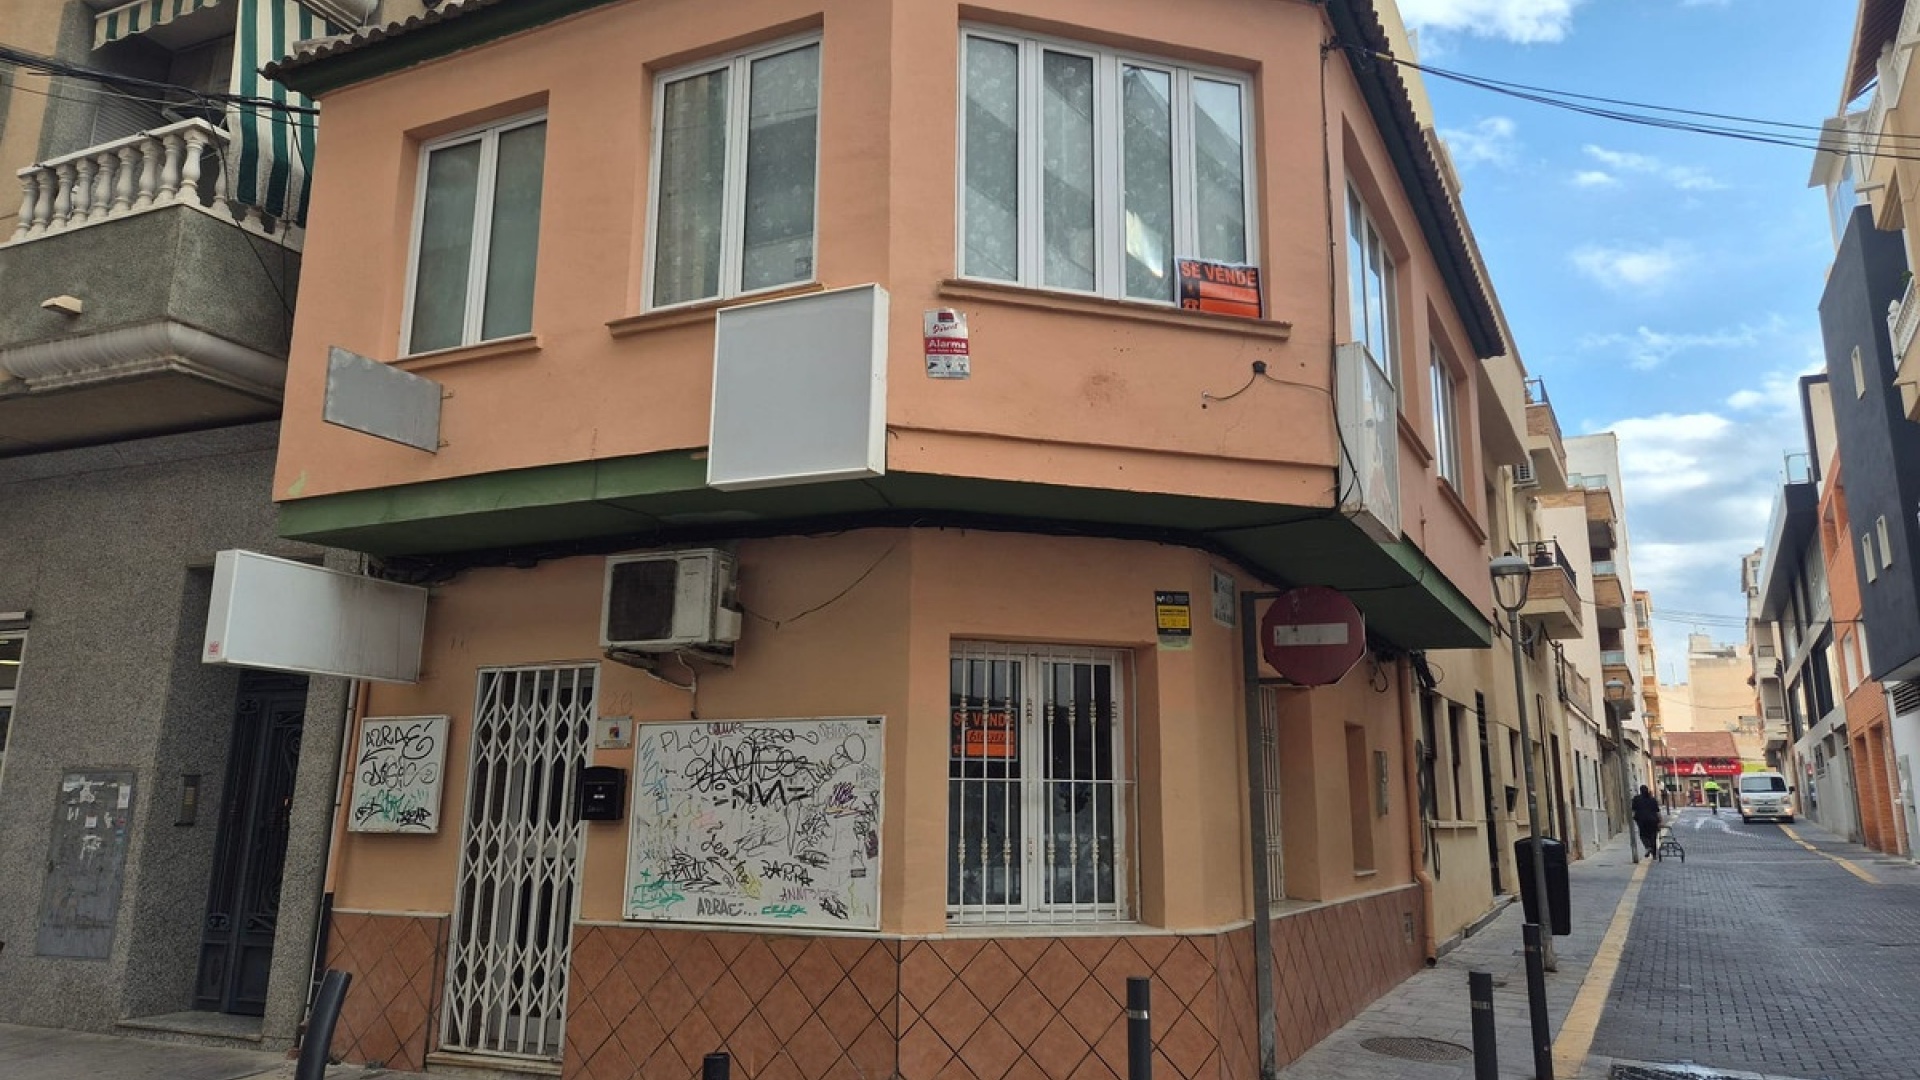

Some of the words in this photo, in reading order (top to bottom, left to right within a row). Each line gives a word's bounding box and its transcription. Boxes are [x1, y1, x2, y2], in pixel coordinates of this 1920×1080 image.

[1181, 261, 1201, 279] SE
[1205, 264, 1257, 287] VENDE
[928, 339, 967, 349] Alarma
[972, 712, 1014, 728] VNDE
